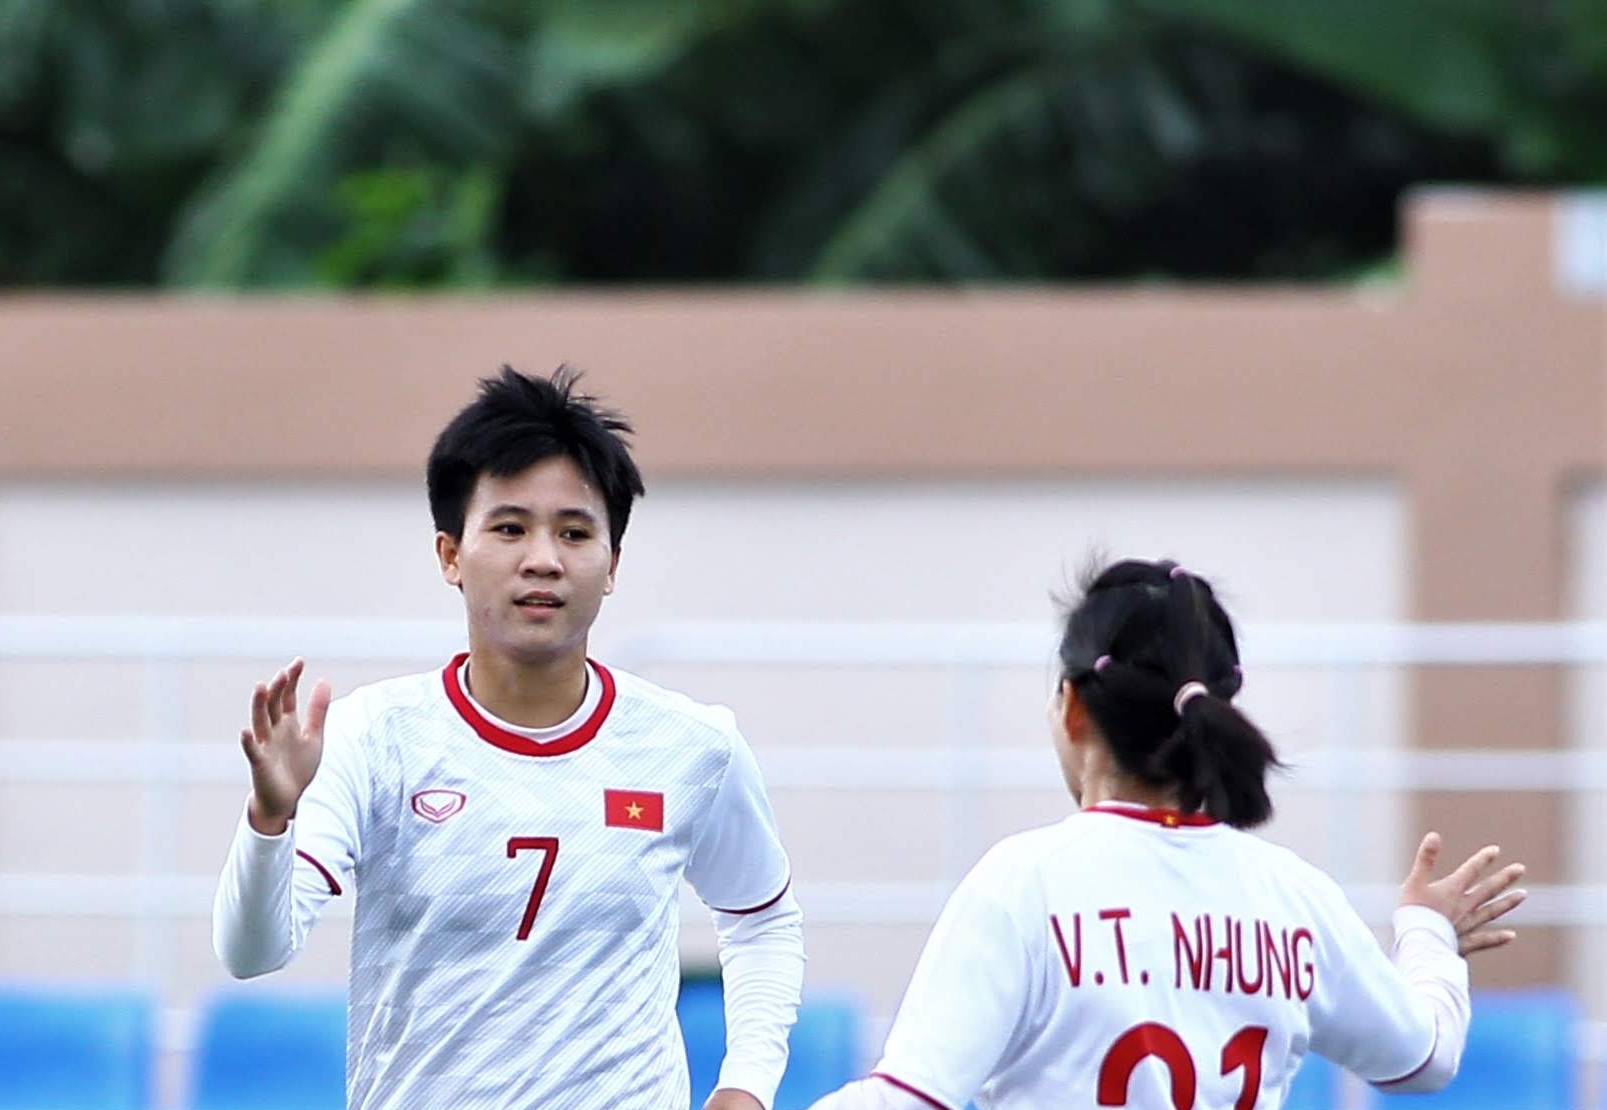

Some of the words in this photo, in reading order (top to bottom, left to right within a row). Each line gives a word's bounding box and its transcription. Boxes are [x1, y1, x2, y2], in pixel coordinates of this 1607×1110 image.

[506, 836, 560, 941] 7
[1050, 908, 1149, 988] V.T.
[1171, 911, 1315, 1002] NHUNG
